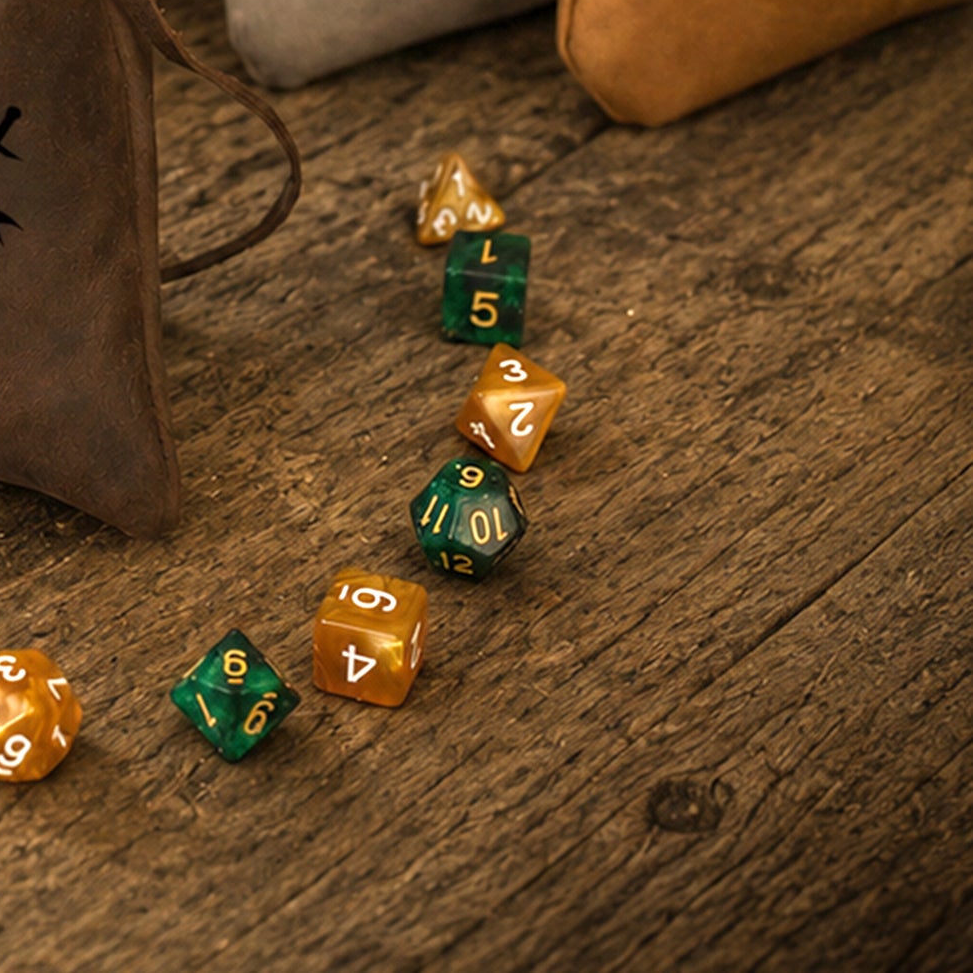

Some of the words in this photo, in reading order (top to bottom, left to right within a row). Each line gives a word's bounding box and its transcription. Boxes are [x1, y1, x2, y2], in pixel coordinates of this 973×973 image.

[469, 291, 501, 328] 5
[498, 358, 529, 383] 3
[508, 401, 535, 437] 2
[439, 550, 475, 576] 12
[222, 648, 249, 686] 6
[341, 643, 378, 684] 4
